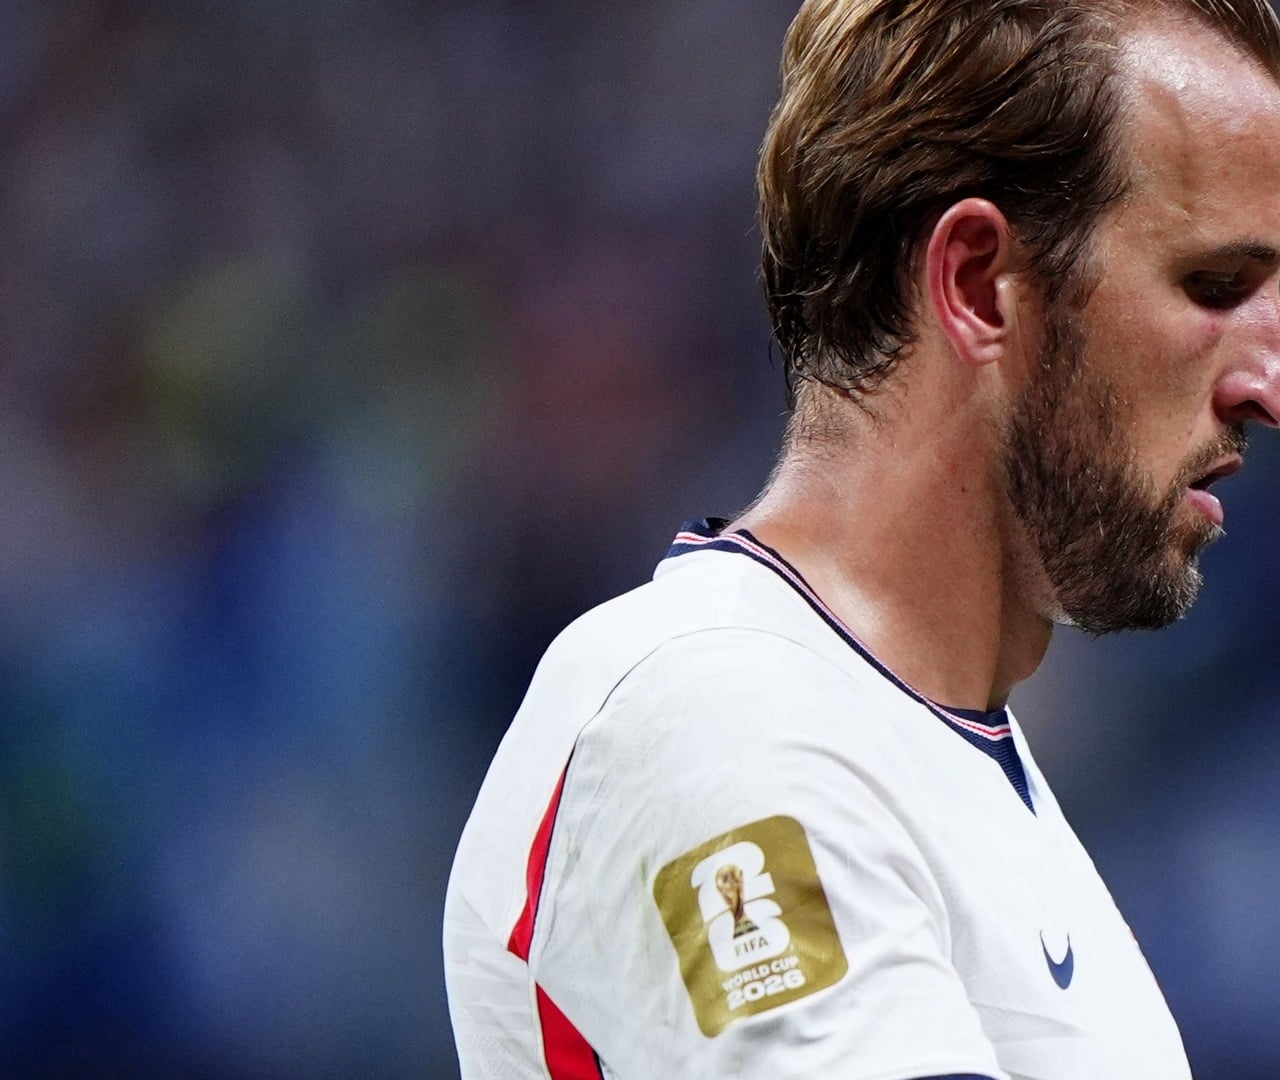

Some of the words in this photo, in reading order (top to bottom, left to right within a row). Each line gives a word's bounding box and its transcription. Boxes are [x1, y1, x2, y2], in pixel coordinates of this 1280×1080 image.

[734, 936, 769, 957] FIFA
[722, 963, 770, 992] WORLD
[771, 956, 799, 974] CUP
[726, 968, 806, 1011] 2026
